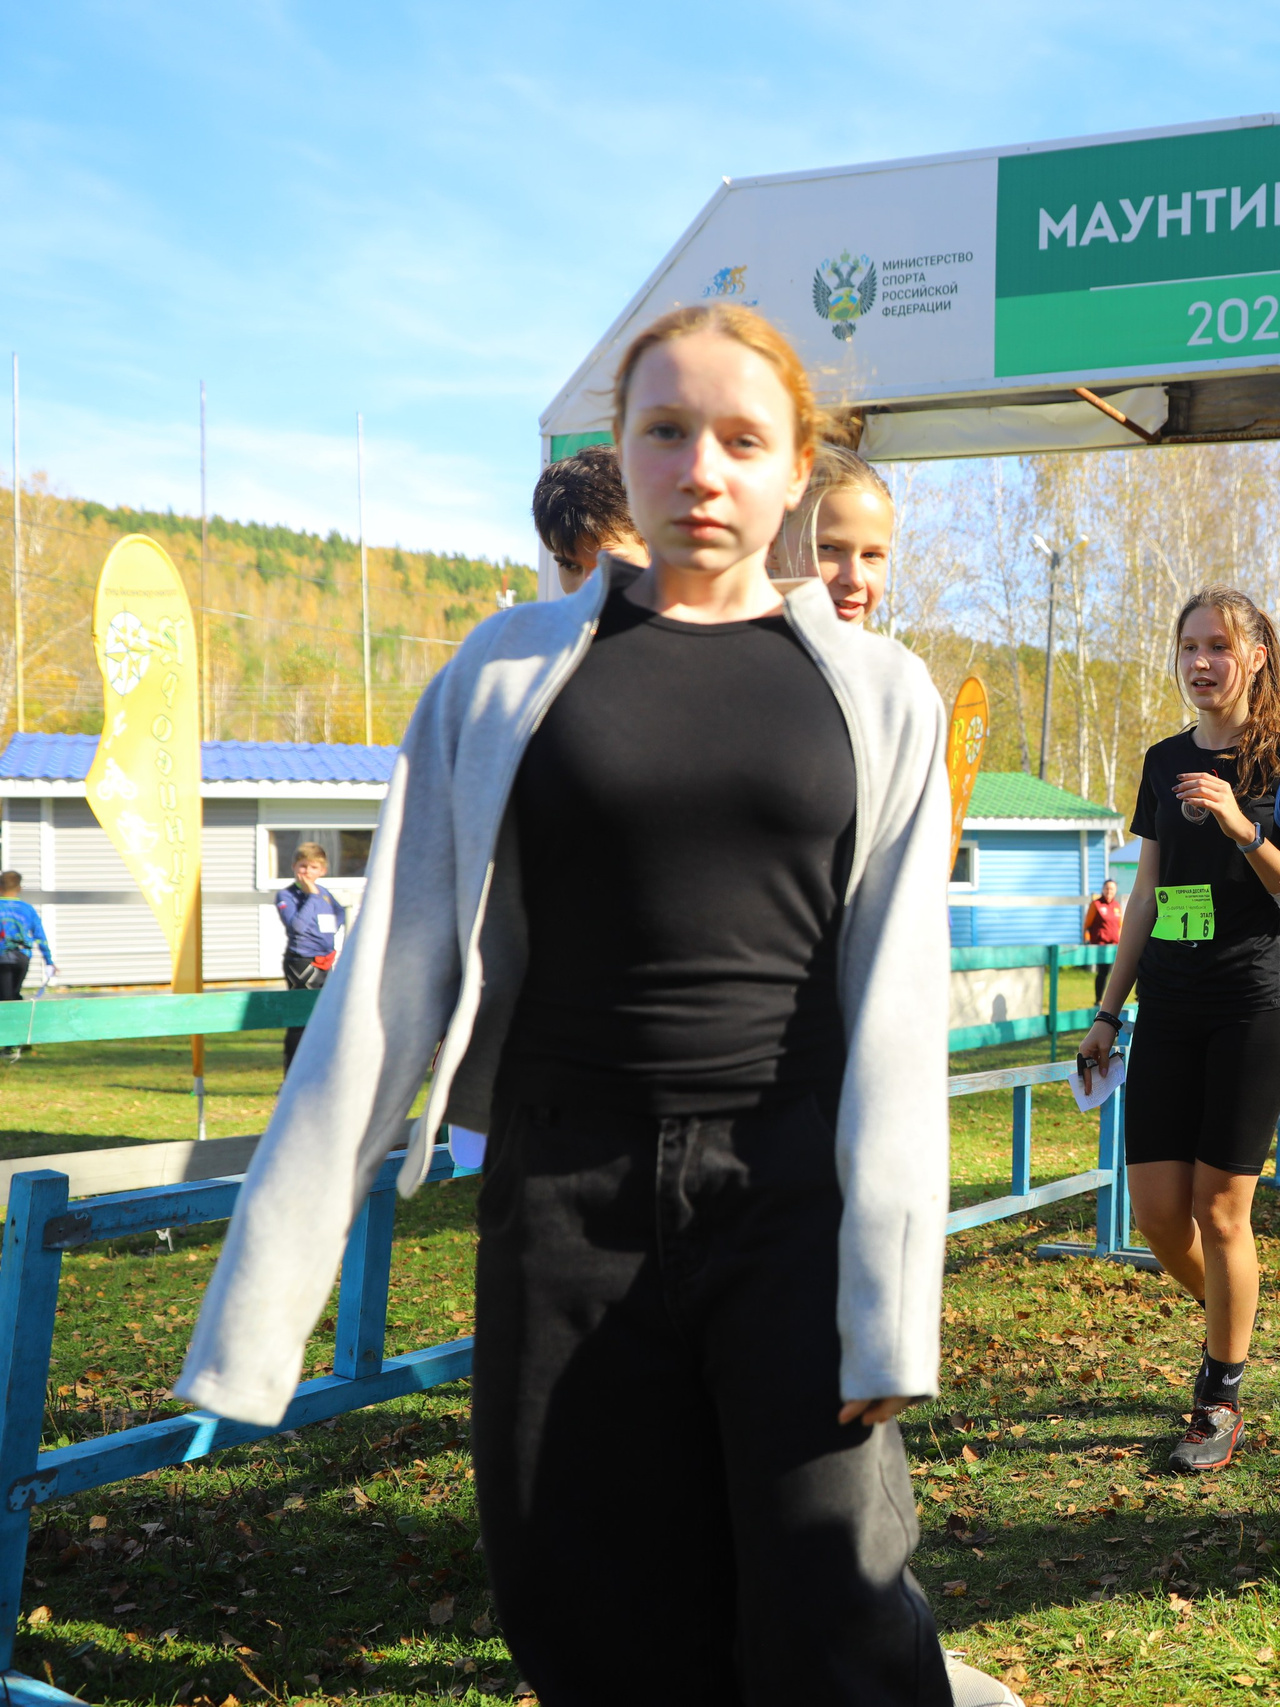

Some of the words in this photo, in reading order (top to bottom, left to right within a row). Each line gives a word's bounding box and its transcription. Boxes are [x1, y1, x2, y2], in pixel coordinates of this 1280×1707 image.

[882, 251, 974, 271] МИНИСТЕРСТВО
[882, 272, 926, 286] СПОРТА
[882, 281, 958, 302] РОССИЙСКОЙ
[881, 300, 951, 317] ФЕДЕРАЦИИ
[1181, 912, 1188, 938] 1
[1203, 919, 1209, 937] 6
